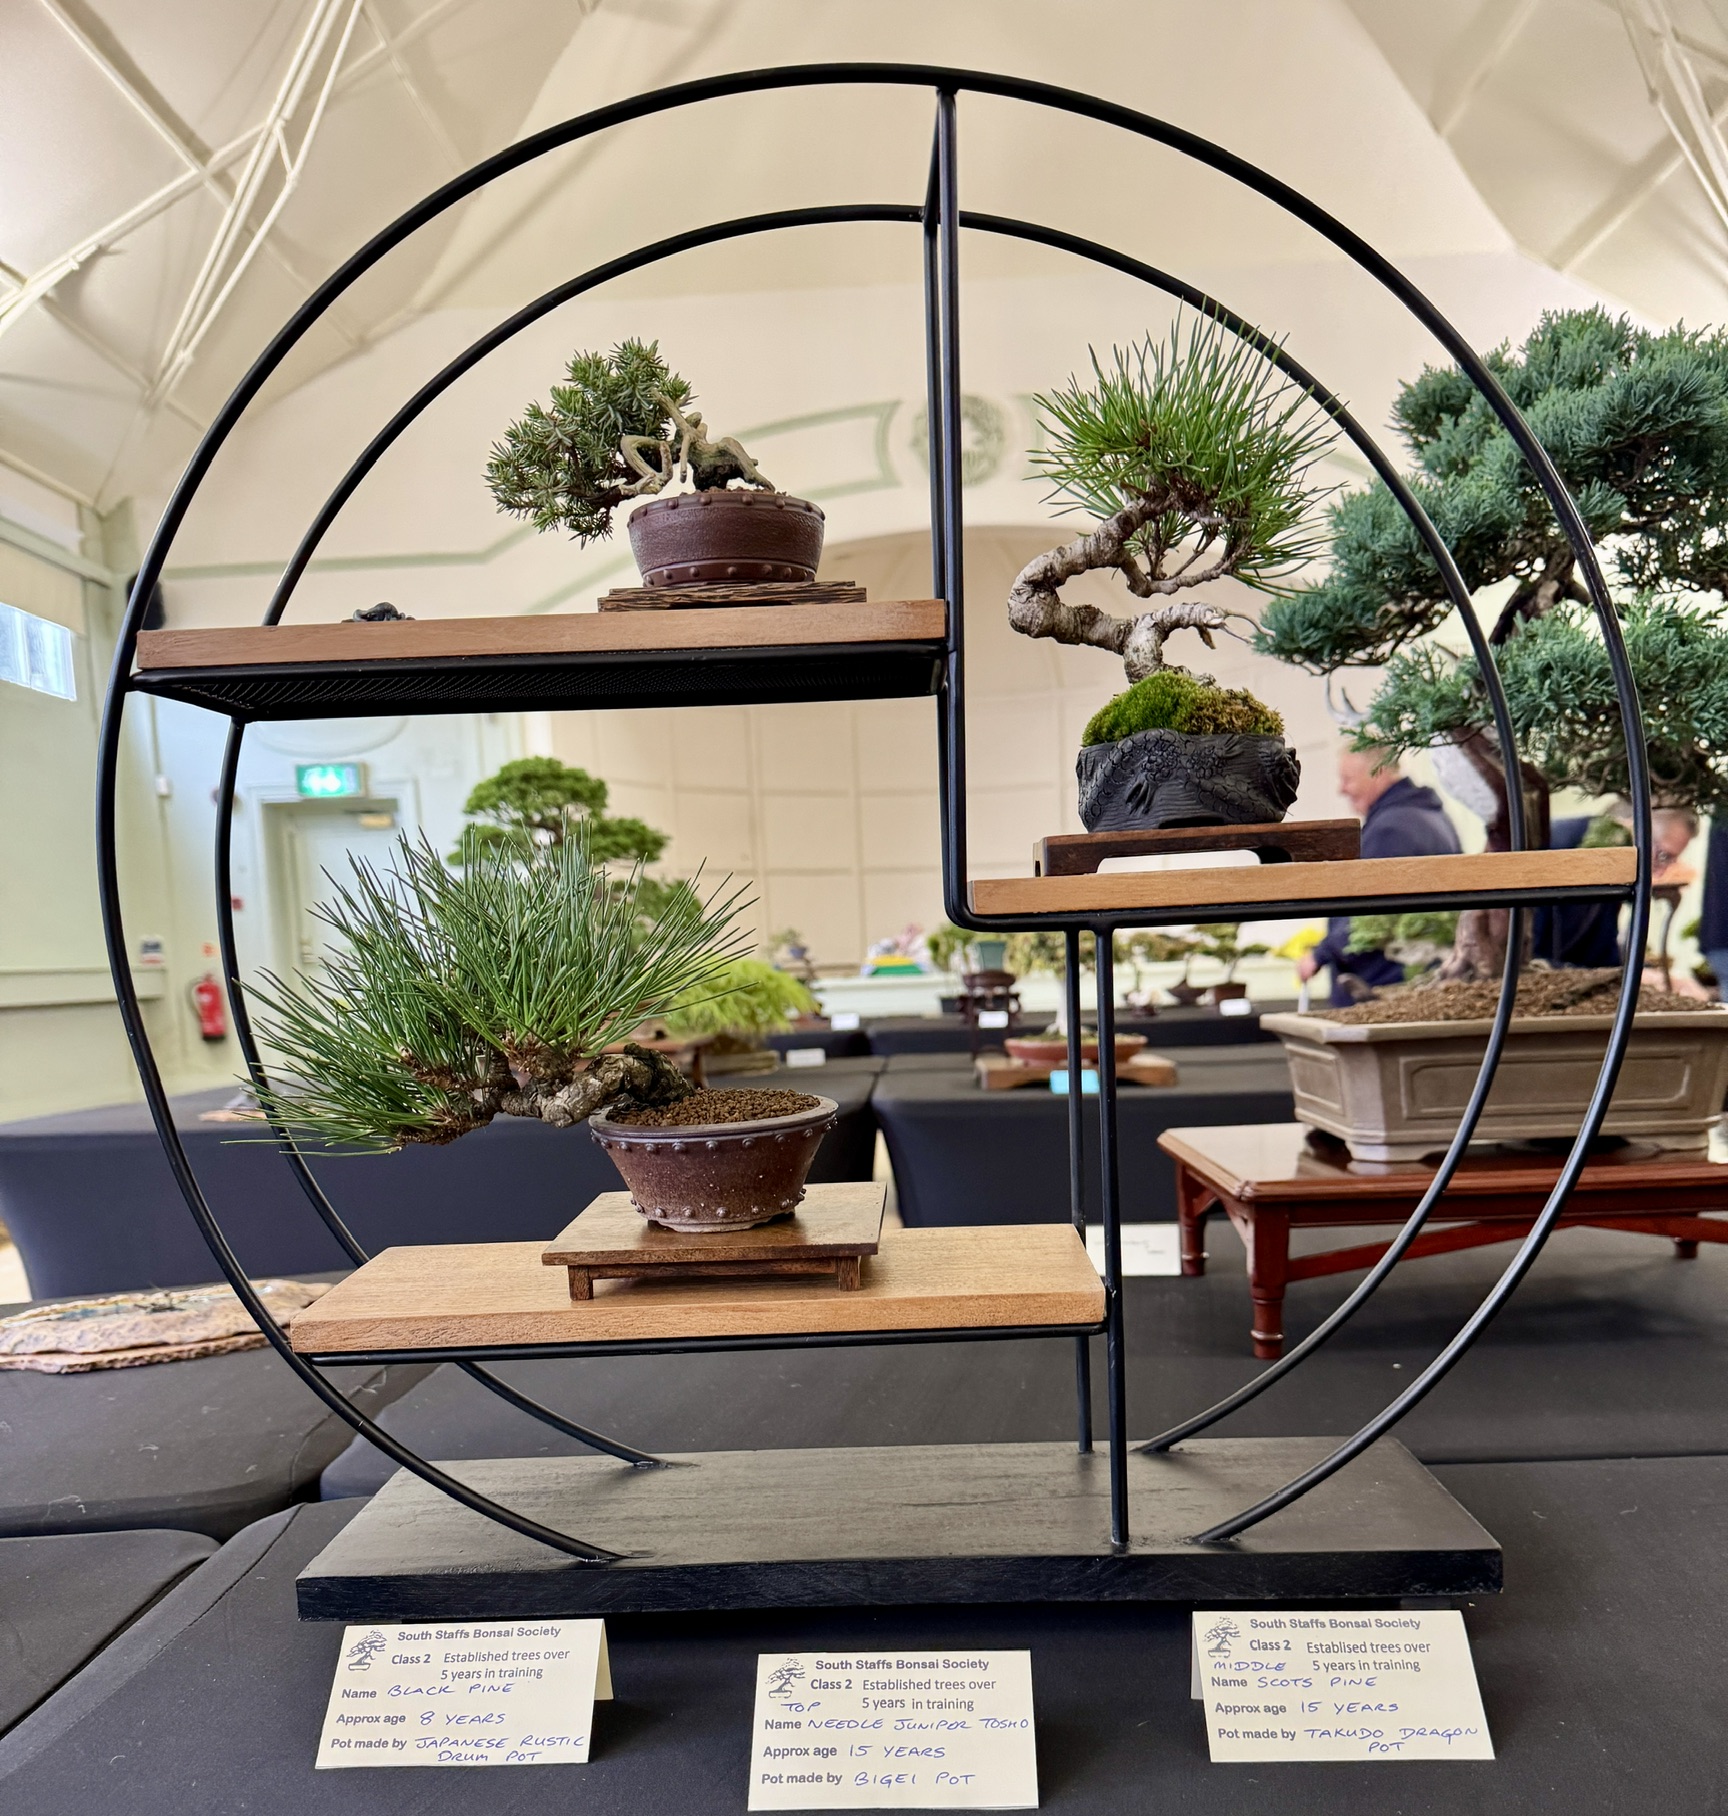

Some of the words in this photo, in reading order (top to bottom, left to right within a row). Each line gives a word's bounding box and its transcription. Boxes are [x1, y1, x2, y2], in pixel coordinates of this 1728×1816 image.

[1250, 1619, 1286, 1628] South
[1290, 1619, 1326, 1628] Staffs
[1330, 1619, 1372, 1628] Bonsai
[1375, 1618, 1420, 1630] Society
[398, 1631, 432, 1641] South
[435, 1630, 470, 1640] Staffs
[473, 1628, 514, 1638] Bonsai
[516, 1626, 561, 1638] Society
[1250, 1640, 1280, 1650] Class
[1284, 1640, 1291, 1650] 2
[1307, 1642, 1367, 1653] Establised
[1370, 1643, 1400, 1653] trees
[1404, 1642, 1430, 1652] over
[392, 1654, 421, 1665] Class
[424, 1654, 430, 1663] 2
[444, 1652, 508, 1663] Established
[512, 1651, 540, 1661] trees
[543, 1650, 570, 1660] over
[816, 1660, 852, 1670] South
[856, 1660, 892, 1669] Staffs
[896, 1659, 939, 1670] Bonsai
[942, 1659, 989, 1671] Society
[1214, 1662, 1286, 1671] MIDDLE
[1312, 1660, 1319, 1670] 5
[1323, 1662, 1355, 1673] years
[1359, 1660, 1370, 1670] in
[1373, 1660, 1420, 1672] training
[441, 1670, 448, 1680] 5
[451, 1670, 481, 1682] years
[485, 1668, 495, 1678] in
[499, 1667, 543, 1679] training
[810, 1679, 841, 1689] Class
[845, 1679, 852, 1689] 2
[863, 1679, 931, 1690] Established
[934, 1680, 965, 1690] trees
[969, 1680, 996, 1689] over
[1212, 1677, 1248, 1687] Name
[1258, 1677, 1312, 1688] SCOTS
[1330, 1677, 1378, 1687] PINE
[342, 1689, 376, 1698] Name
[388, 1685, 455, 1697] BLACK
[469, 1683, 515, 1694] PINE
[781, 1702, 821, 1712] TOP
[862, 1698, 869, 1709] 5
[873, 1698, 905, 1711] years
[912, 1698, 923, 1709] in
[926, 1698, 974, 1711] training
[1215, 1703, 1260, 1715] Approx
[1264, 1704, 1286, 1715] age
[1302, 1702, 1322, 1712] 15
[1334, 1702, 1399, 1714] YEARS
[336, 1714, 380, 1726] Approx
[383, 1714, 406, 1726] age
[420, 1711, 434, 1726] 8
[446, 1714, 506, 1725] YEARS
[807, 1719, 884, 1729] NEEDLE
[765, 1720, 801, 1730] Name
[1218, 1729, 1240, 1738] Pot
[1243, 1729, 1278, 1739] made
[1280, 1729, 1296, 1740] by
[1304, 1728, 1384, 1739] TAKUDO
[1400, 1728, 1478, 1744] DRAGON
[331, 1739, 351, 1748] Pot
[354, 1738, 389, 1748] made
[392, 1738, 407, 1750] by
[414, 1737, 509, 1749] JAPANESE
[520, 1735, 585, 1746] RUSTIC
[1368, 1742, 1405, 1752] POT
[506, 1751, 542, 1761] POT
[763, 1747, 809, 1759] Approx
[813, 1747, 837, 1758] age
[850, 1745, 873, 1757] 15
[884, 1747, 945, 1758] YEARS
[762, 1774, 784, 1783] Pot
[787, 1773, 823, 1784] made
[826, 1773, 842, 1785] by
[935, 1772, 975, 1785] POT
